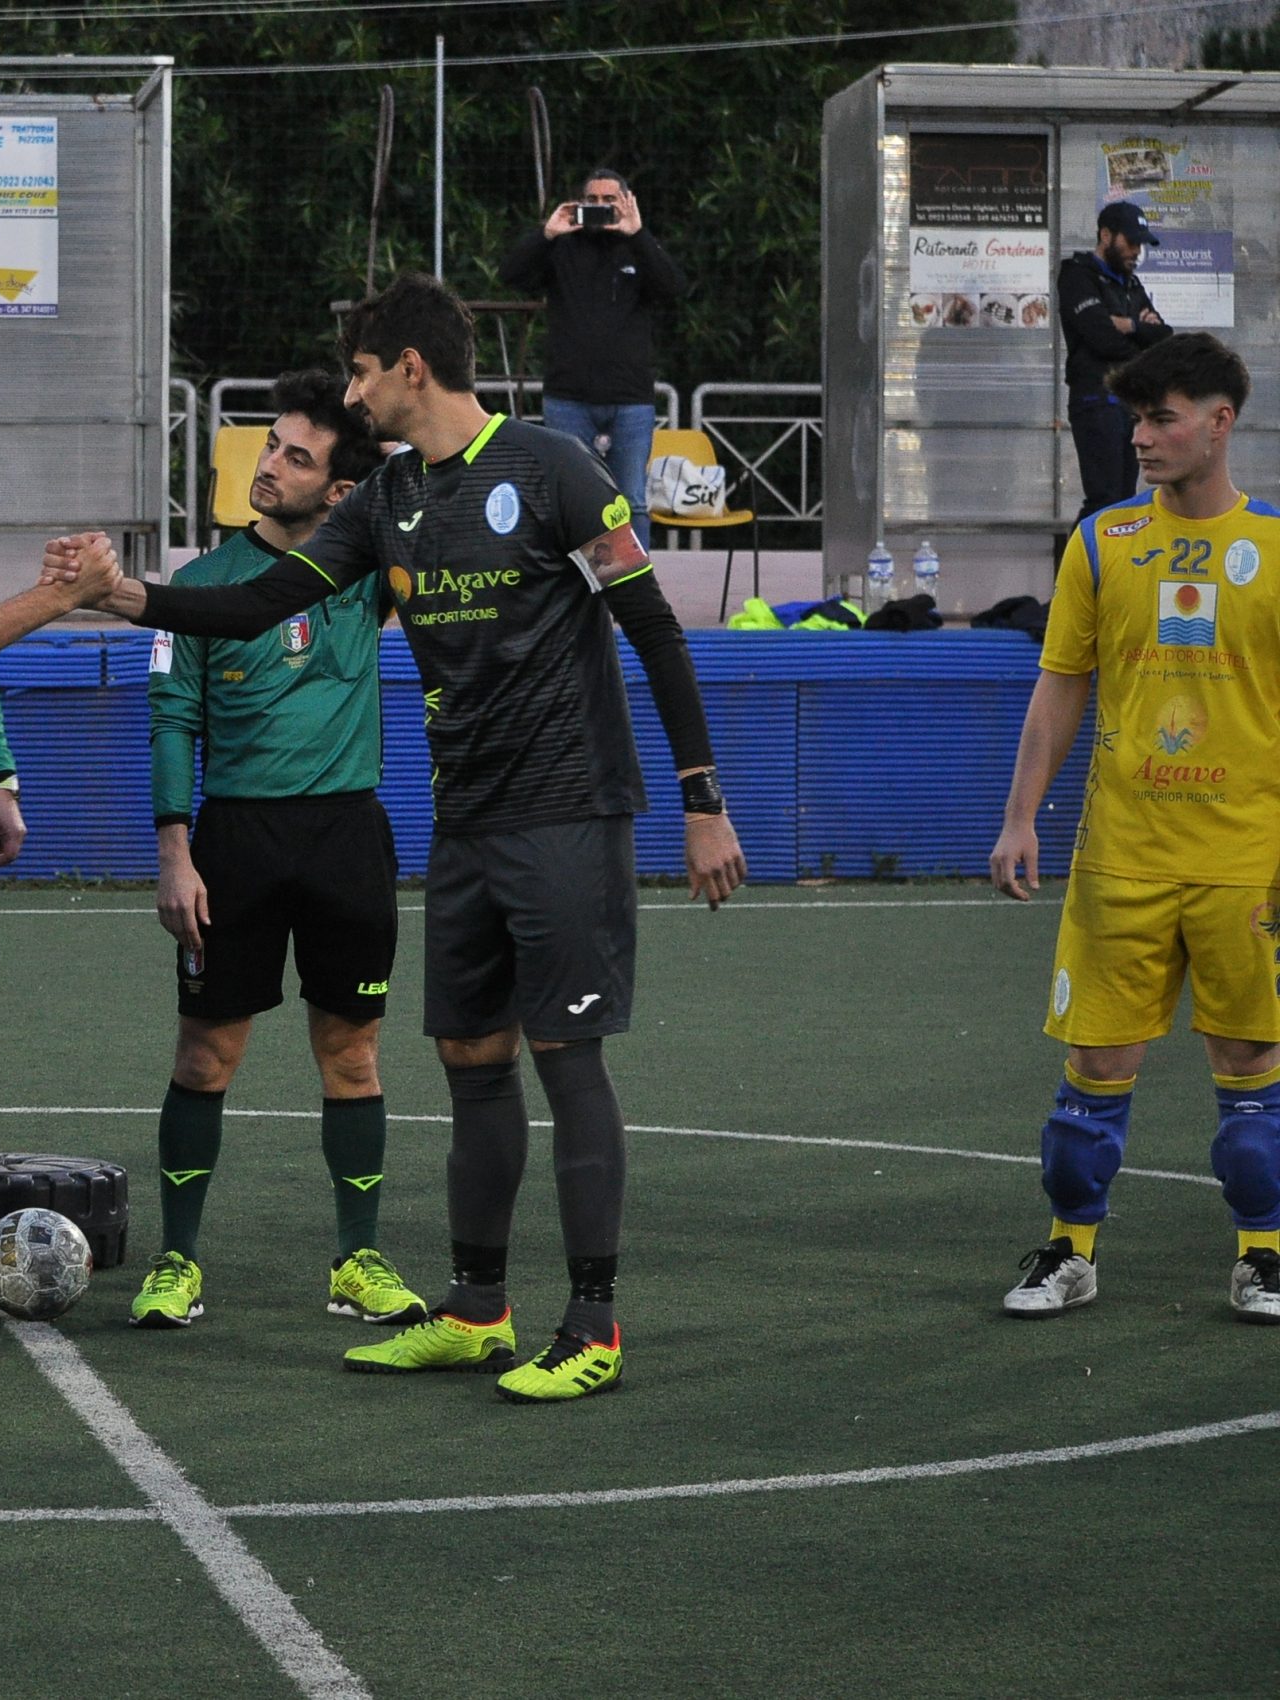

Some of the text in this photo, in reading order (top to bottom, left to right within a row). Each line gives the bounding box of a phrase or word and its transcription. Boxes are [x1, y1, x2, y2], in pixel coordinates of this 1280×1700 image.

[10, 125, 55, 133] TRATTORIA
[18, 135, 55, 144] PIZZERIA
[22, 176, 55, 187] 621043
[18, 191, 47, 199] COUS
[951, 203, 971, 211] Dante
[913, 236, 1045, 257] Ristorante Gardenia
[1181, 247, 1213, 260] tourist
[962, 259, 997, 270] HOTEL
[1170, 537, 1212, 576] 22
[416, 568, 521, 604] L'Agave
[411, 607, 499, 626] COMFORT ROOMS
[1120, 648, 1160, 662] SABBIA
[1164, 649, 1205, 663] D'ORO
[1131, 754, 1227, 790] Agave
[1133, 790, 1226, 804] SUPERIOR ROOMS
[447, 1321, 472, 1334] COPA
